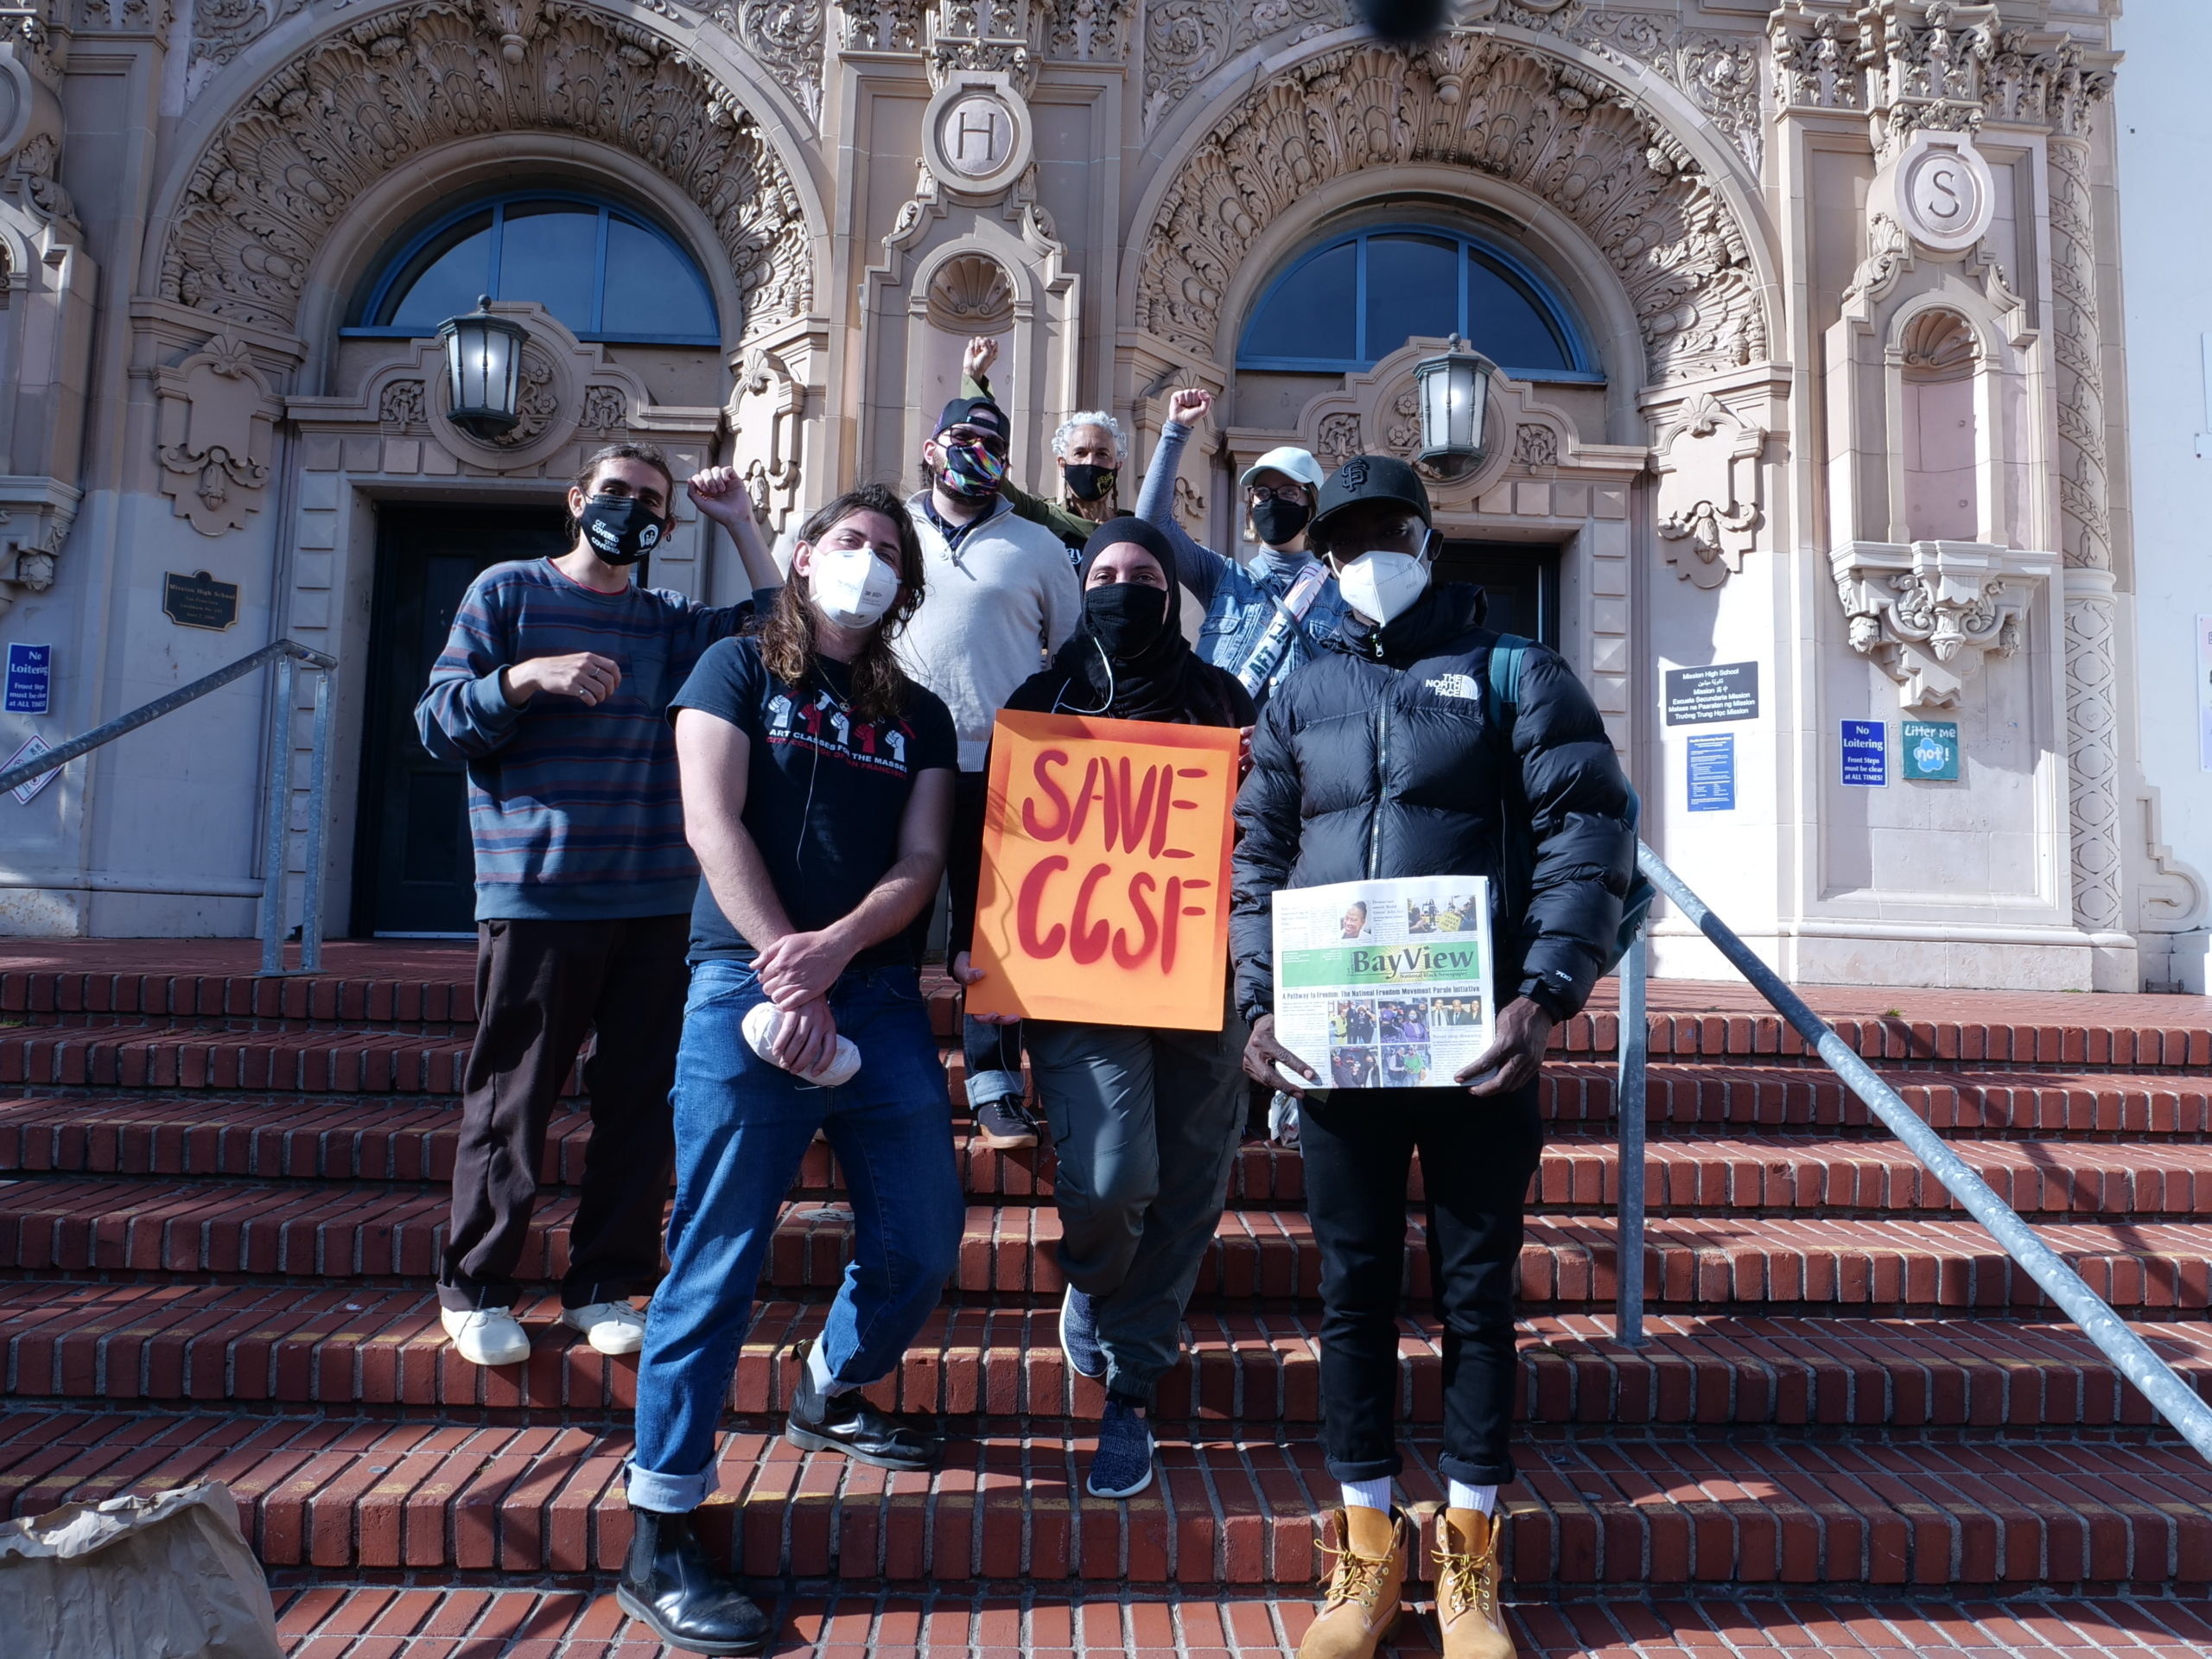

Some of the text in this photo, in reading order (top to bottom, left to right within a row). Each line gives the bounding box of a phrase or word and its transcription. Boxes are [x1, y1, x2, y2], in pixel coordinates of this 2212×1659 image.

[956, 111, 995, 161] H
[1928, 169, 1960, 219] S
[592, 524, 619, 543] COVERED
[591, 537, 620, 554] COVERED
[169, 584, 194, 593] Mission
[214, 591, 236, 600] School
[29, 651, 42, 660] No
[1249, 645, 1277, 680] AFT
[11, 664, 48, 677] Loitering
[1682, 671, 1704, 680] Mission
[1719, 668, 1739, 677] School
[1425, 679, 1461, 691] NORTH
[1442, 673, 1463, 683] THE
[1434, 686, 1461, 697] FACE
[1695, 695, 1728, 703] Secundaria
[1856, 726, 1870, 734] No
[1904, 724, 1956, 738] Litter me
[792, 732, 836, 751] CLASSES
[851, 753, 872, 762] THE
[1843, 738, 1884, 752] Loitering
[1863, 757, 1880, 766] Steps
[1021, 749, 1208, 860] SAVE
[1353, 947, 1474, 979] BayView
